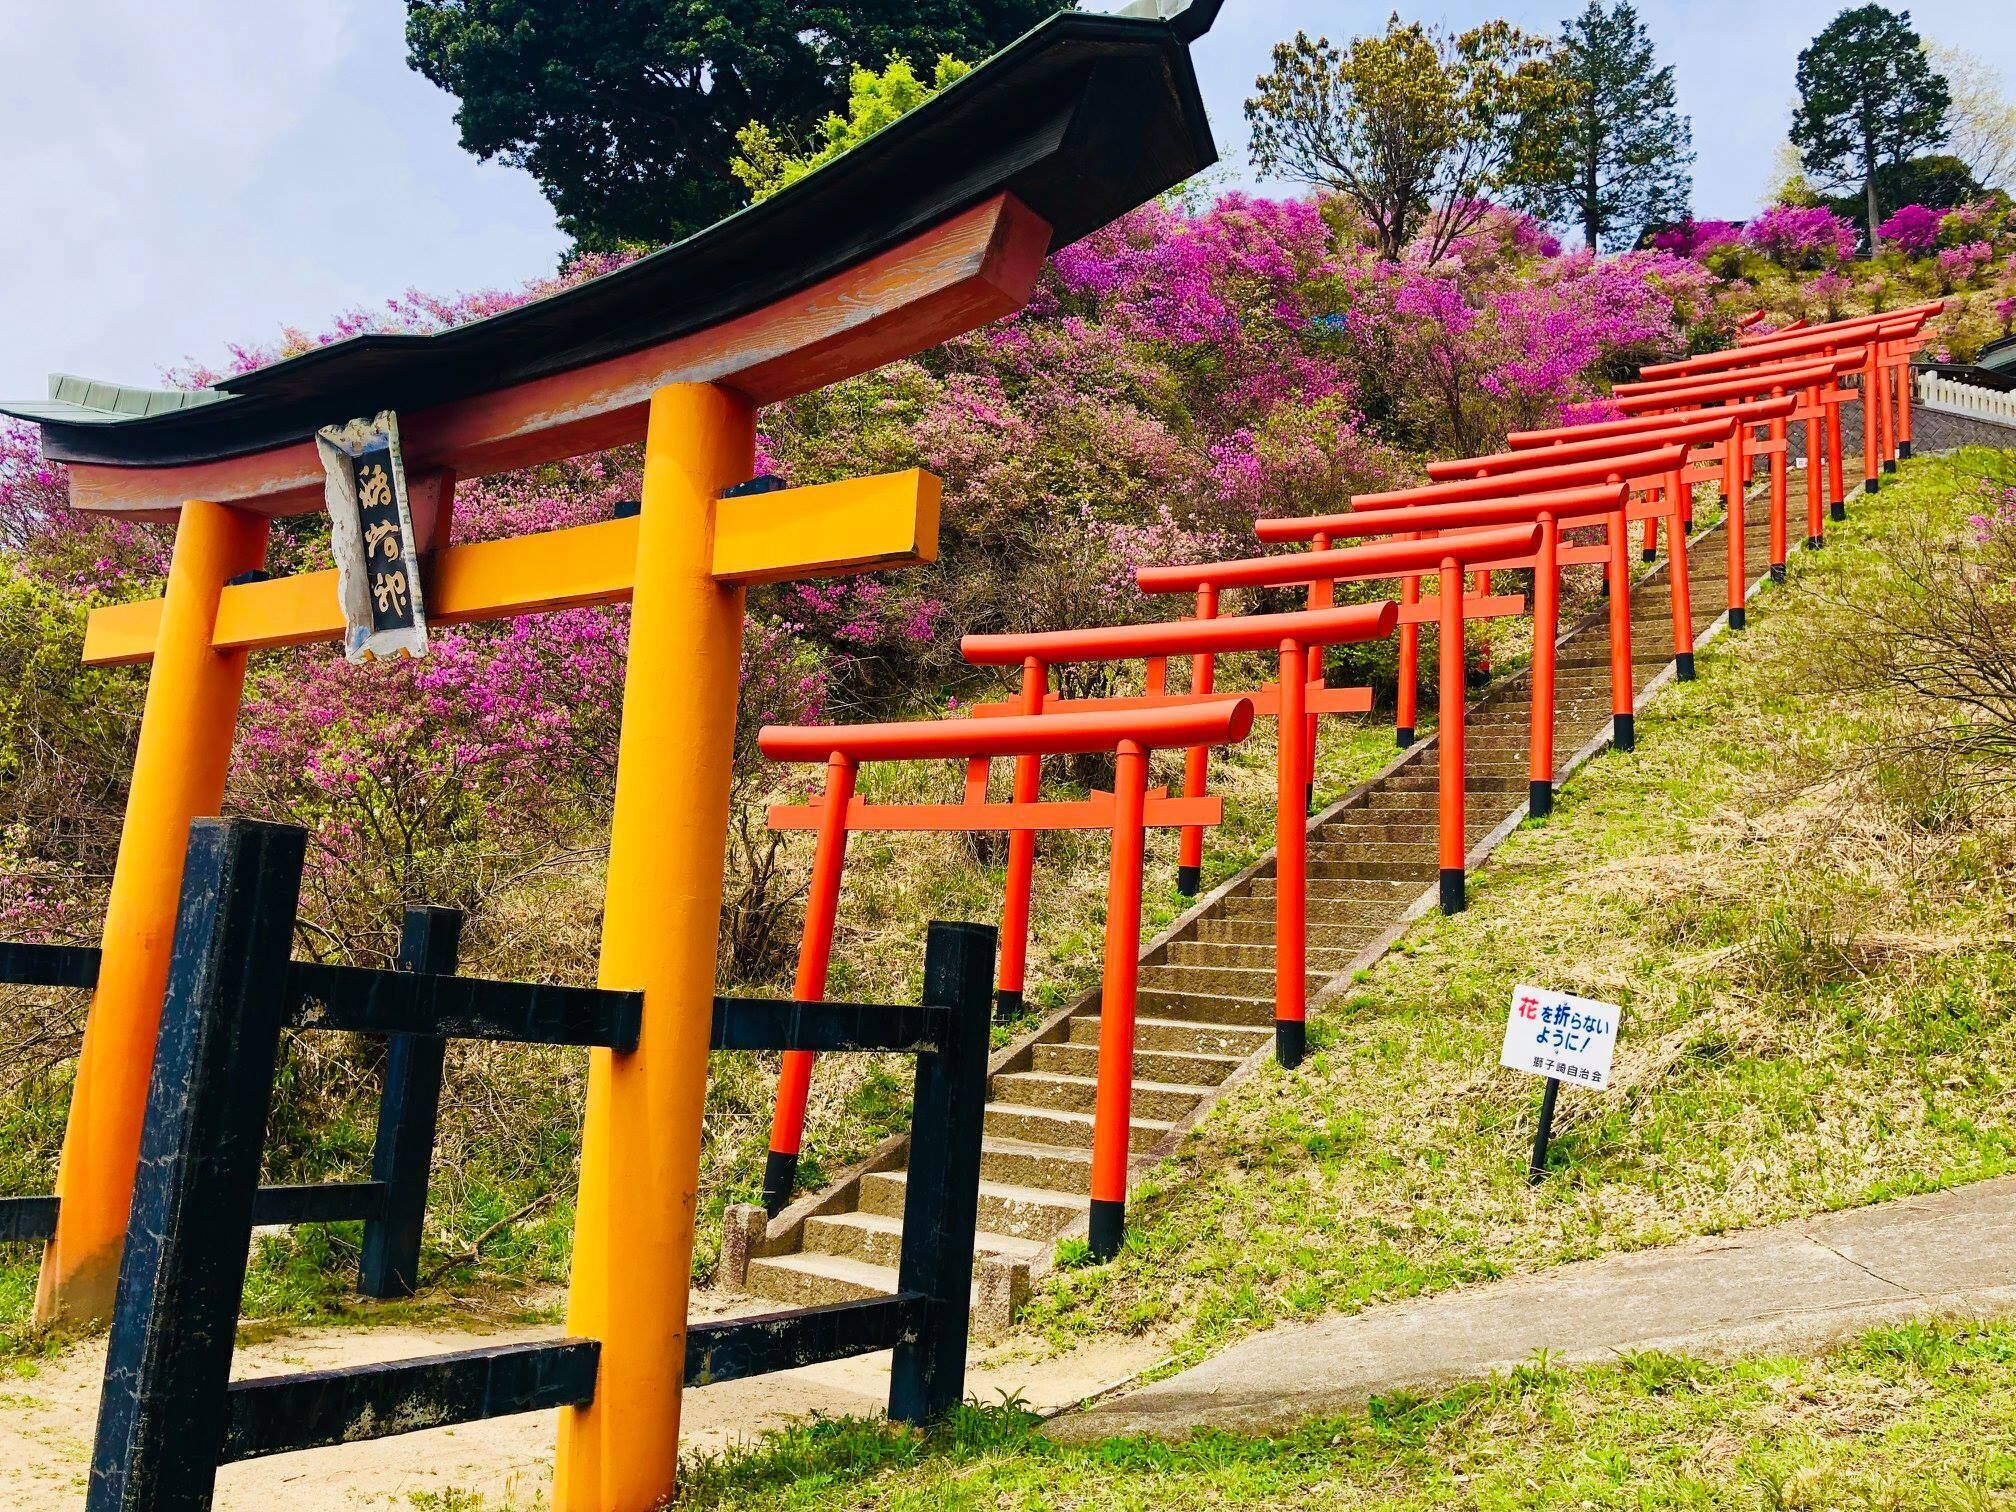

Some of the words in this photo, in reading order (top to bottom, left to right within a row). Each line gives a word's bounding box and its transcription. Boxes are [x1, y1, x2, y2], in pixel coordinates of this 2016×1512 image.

[1518, 996, 1609, 1034] 花を折らない
